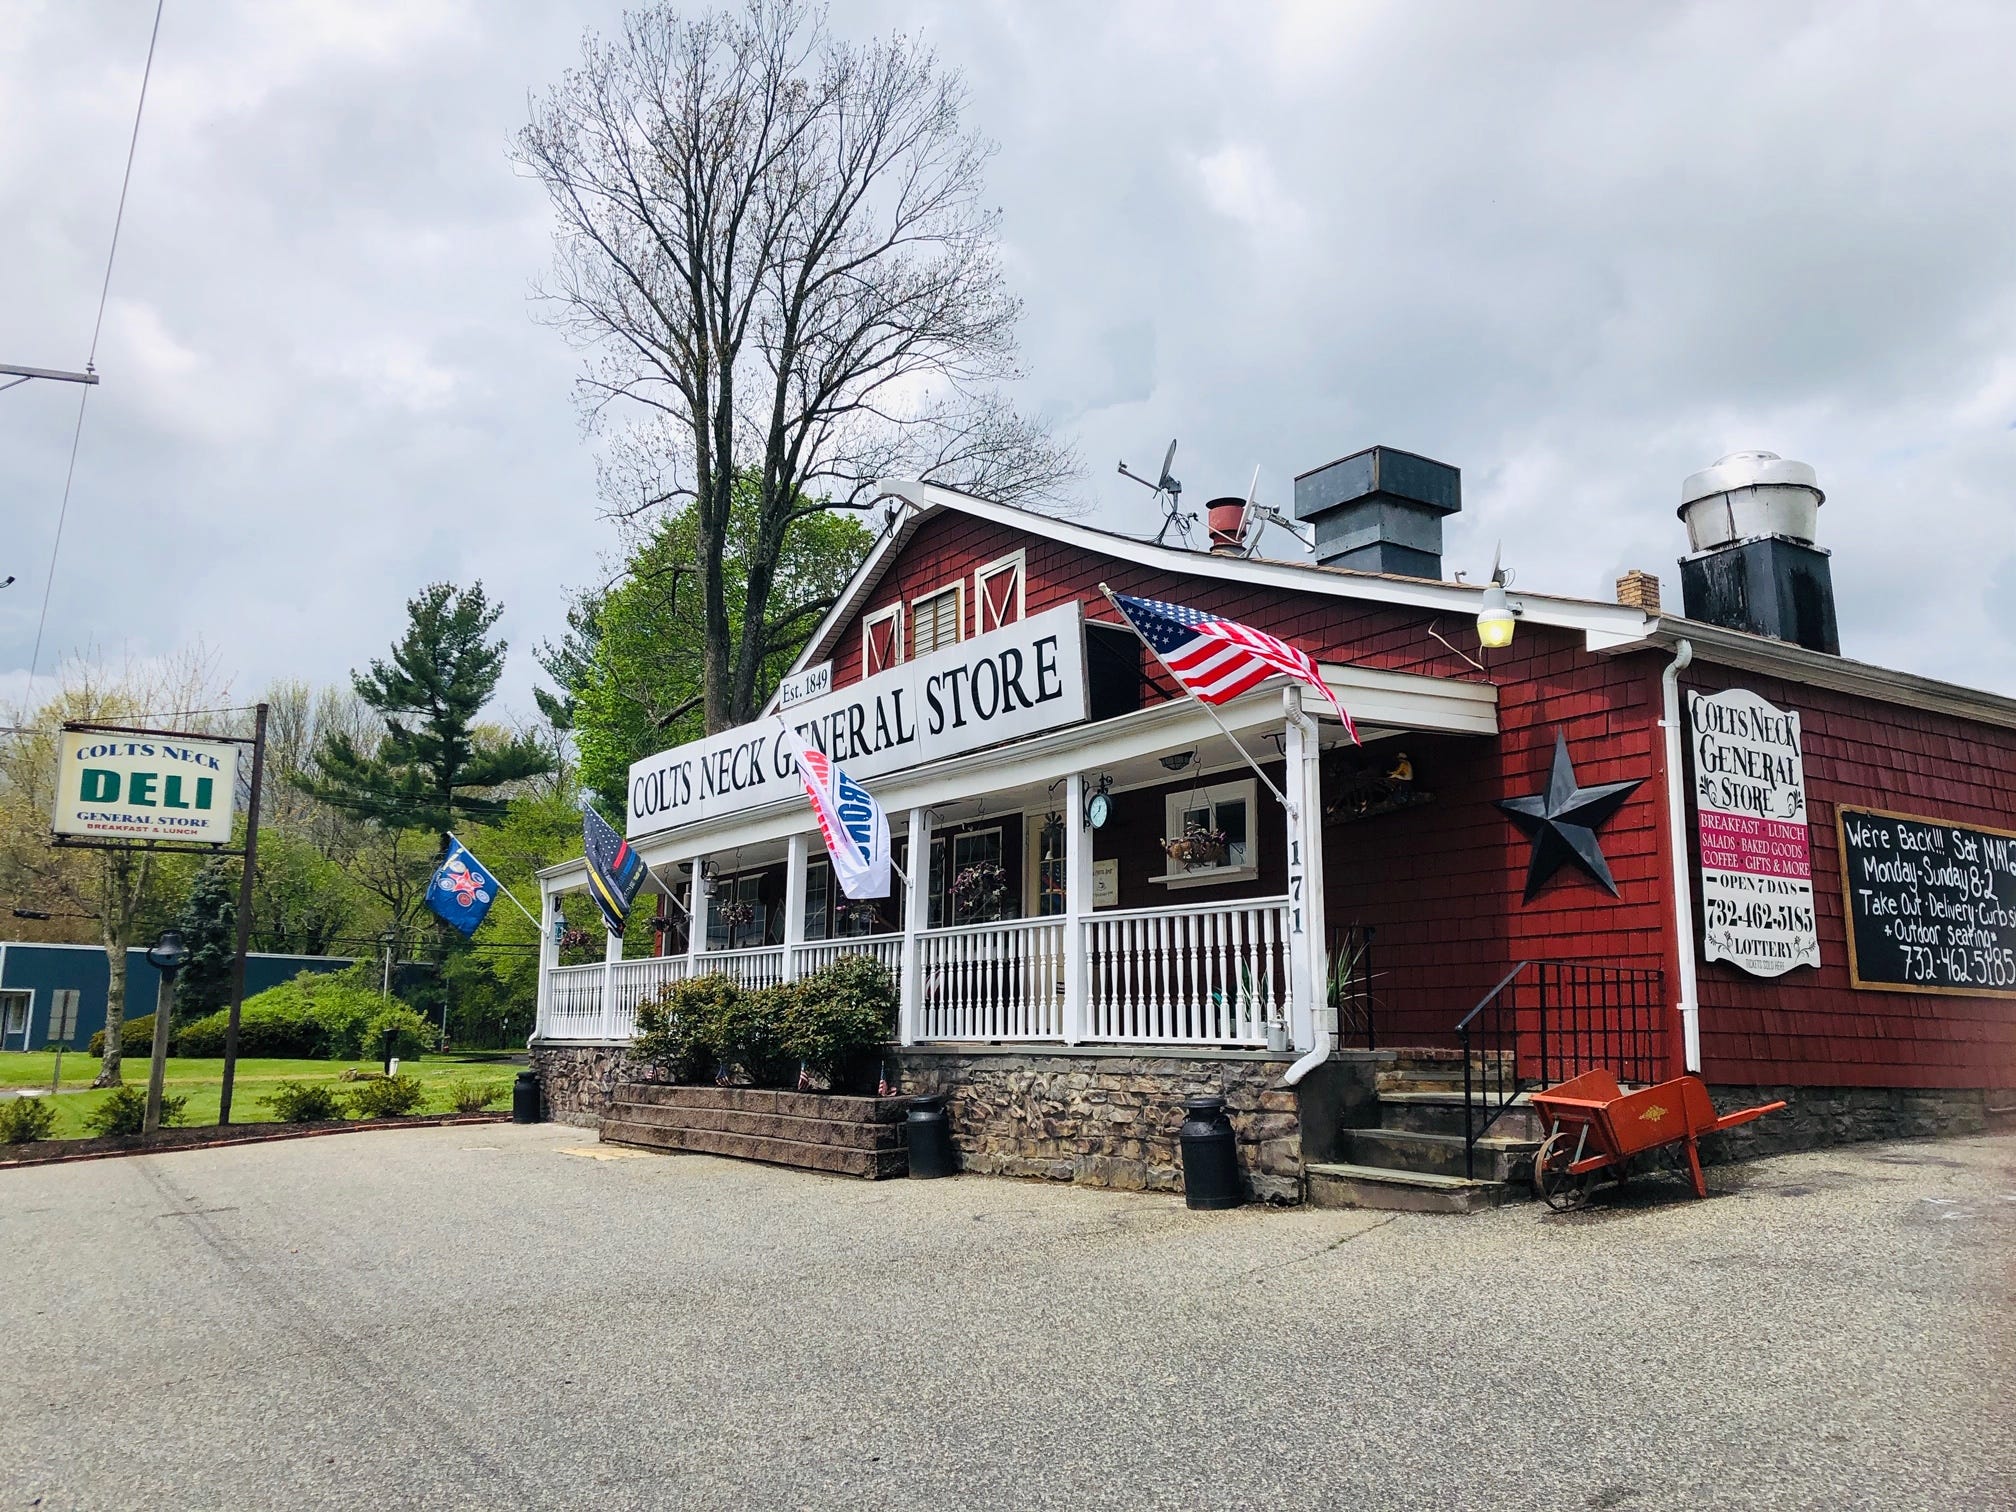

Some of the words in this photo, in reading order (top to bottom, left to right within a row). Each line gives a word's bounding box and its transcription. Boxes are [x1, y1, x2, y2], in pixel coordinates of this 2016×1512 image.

[782, 683, 802, 703] Est.
[805, 668, 828, 695] 1849
[633, 761, 692, 818] COLTS
[699, 736, 766, 801] NECK
[926, 635, 1063, 736] STORE
[1692, 696, 1748, 738] COLTS
[1749, 706, 1799, 757] NECK
[77, 743, 155, 761] COLTS
[162, 746, 220, 771] NECK
[1700, 734, 1799, 791] GENERAL
[80, 768, 213, 810] DELI
[1722, 777, 1775, 818] STORE
[77, 811, 154, 825] GENERAL
[157, 816, 210, 828] STORE
[87, 823, 149, 833] BREAKFAST
[163, 827, 198, 835] LUNCH
[1700, 813, 1759, 835] BREAKFAST
[1768, 823, 1805, 841] LUNCH
[1702, 832, 1736, 850] SALADS
[1741, 838, 1770, 854] BAKED
[1771, 841, 1803, 859] GOODS
[1846, 820, 1891, 849] We're
[1897, 824, 1945, 855] Back!!!
[1952, 830, 1980, 863] Sat
[1703, 850, 1739, 868] COFFEE
[1745, 855, 1771, 871] GIFTS
[1773, 859, 1780, 872] &
[1782, 861, 1811, 876] MORE
[1720, 874, 1755, 891] OPEN
[1758, 878, 1765, 894] 7
[1767, 880, 1797, 896] DAYS
[1707, 898, 1813, 933] 732-462-5185
[1859, 889, 1898, 916] Take
[1901, 892, 1922, 916] Out
[1894, 918, 1941, 945] Outdoor
[1735, 938, 1793, 958] LOTTERY
